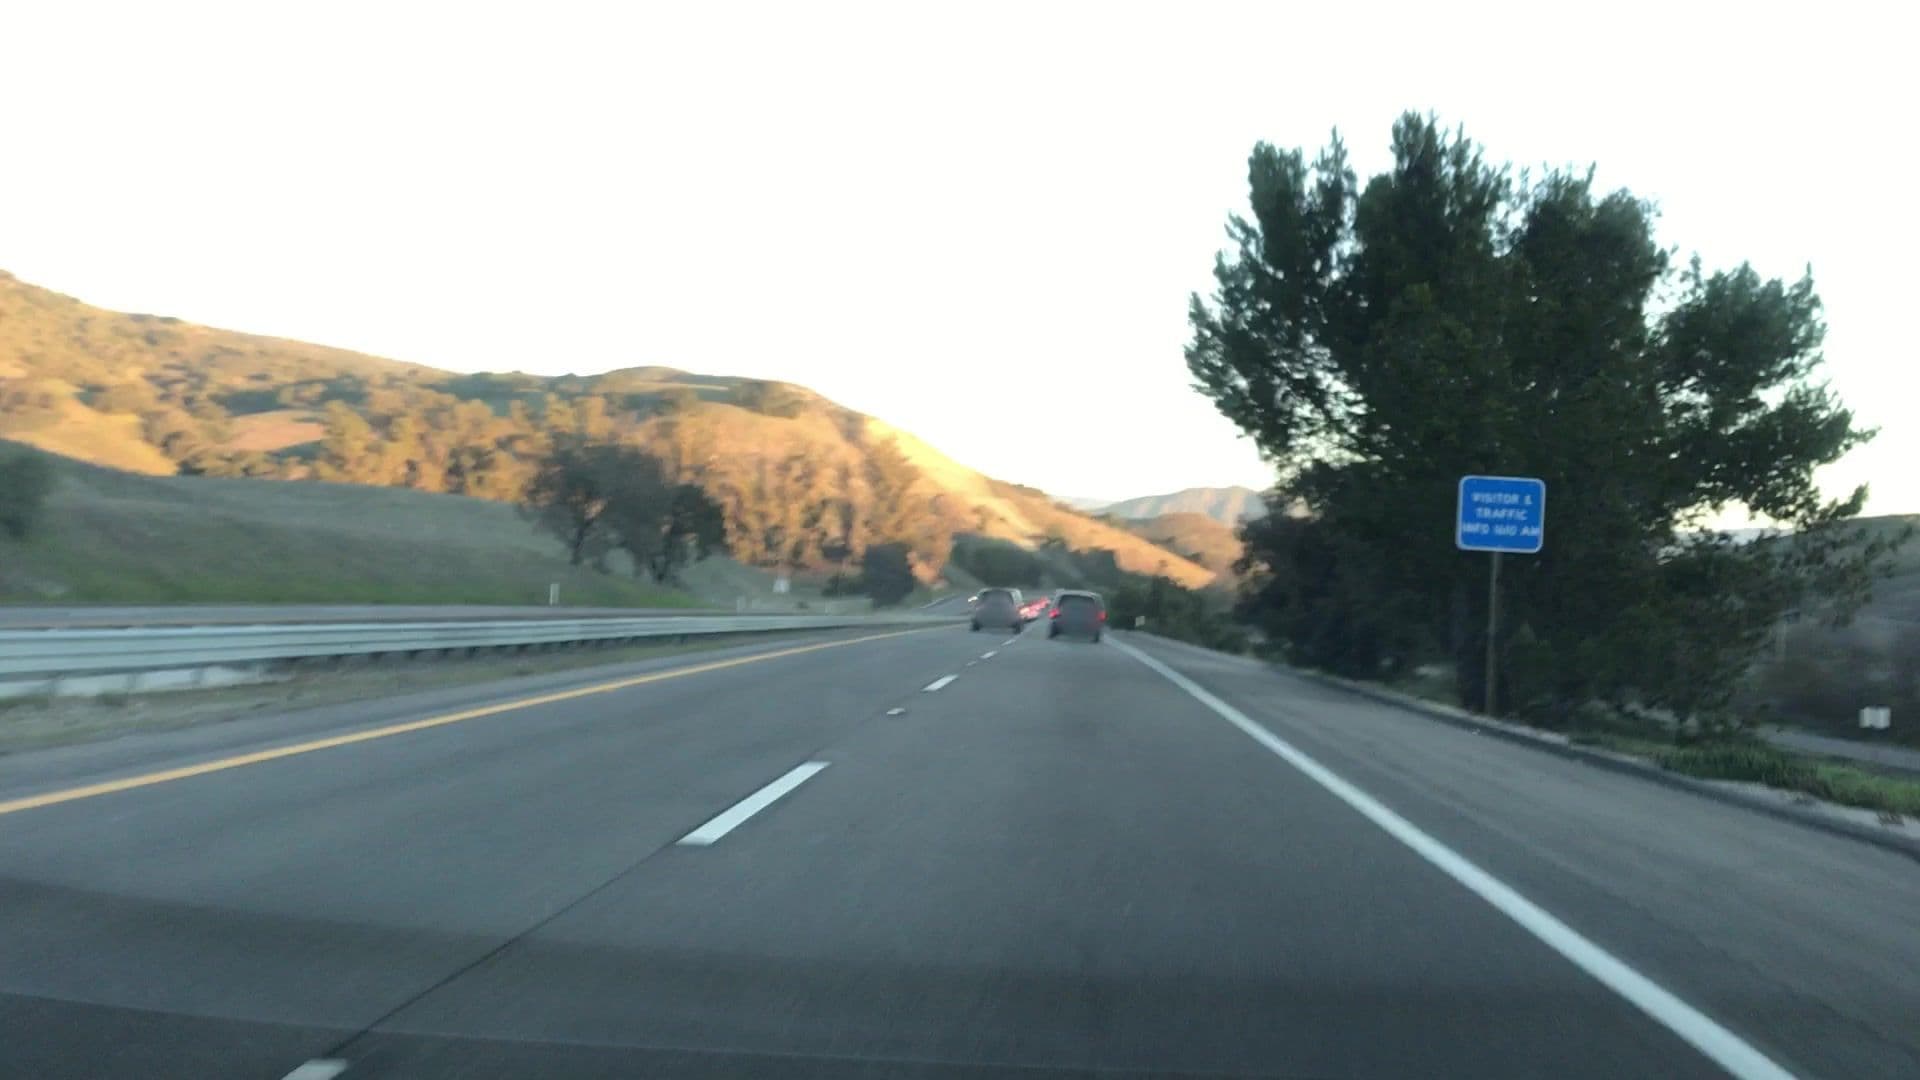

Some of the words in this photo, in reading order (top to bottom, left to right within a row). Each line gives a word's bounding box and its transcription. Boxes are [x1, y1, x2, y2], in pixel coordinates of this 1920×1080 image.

[1471, 492, 1519, 504] VISITOR
[1523, 494, 1533, 505] &
[1475, 507, 1528, 520] TRAFFIC
[1462, 522, 1489, 534] INFO
[1520, 526, 1540, 536] AM
